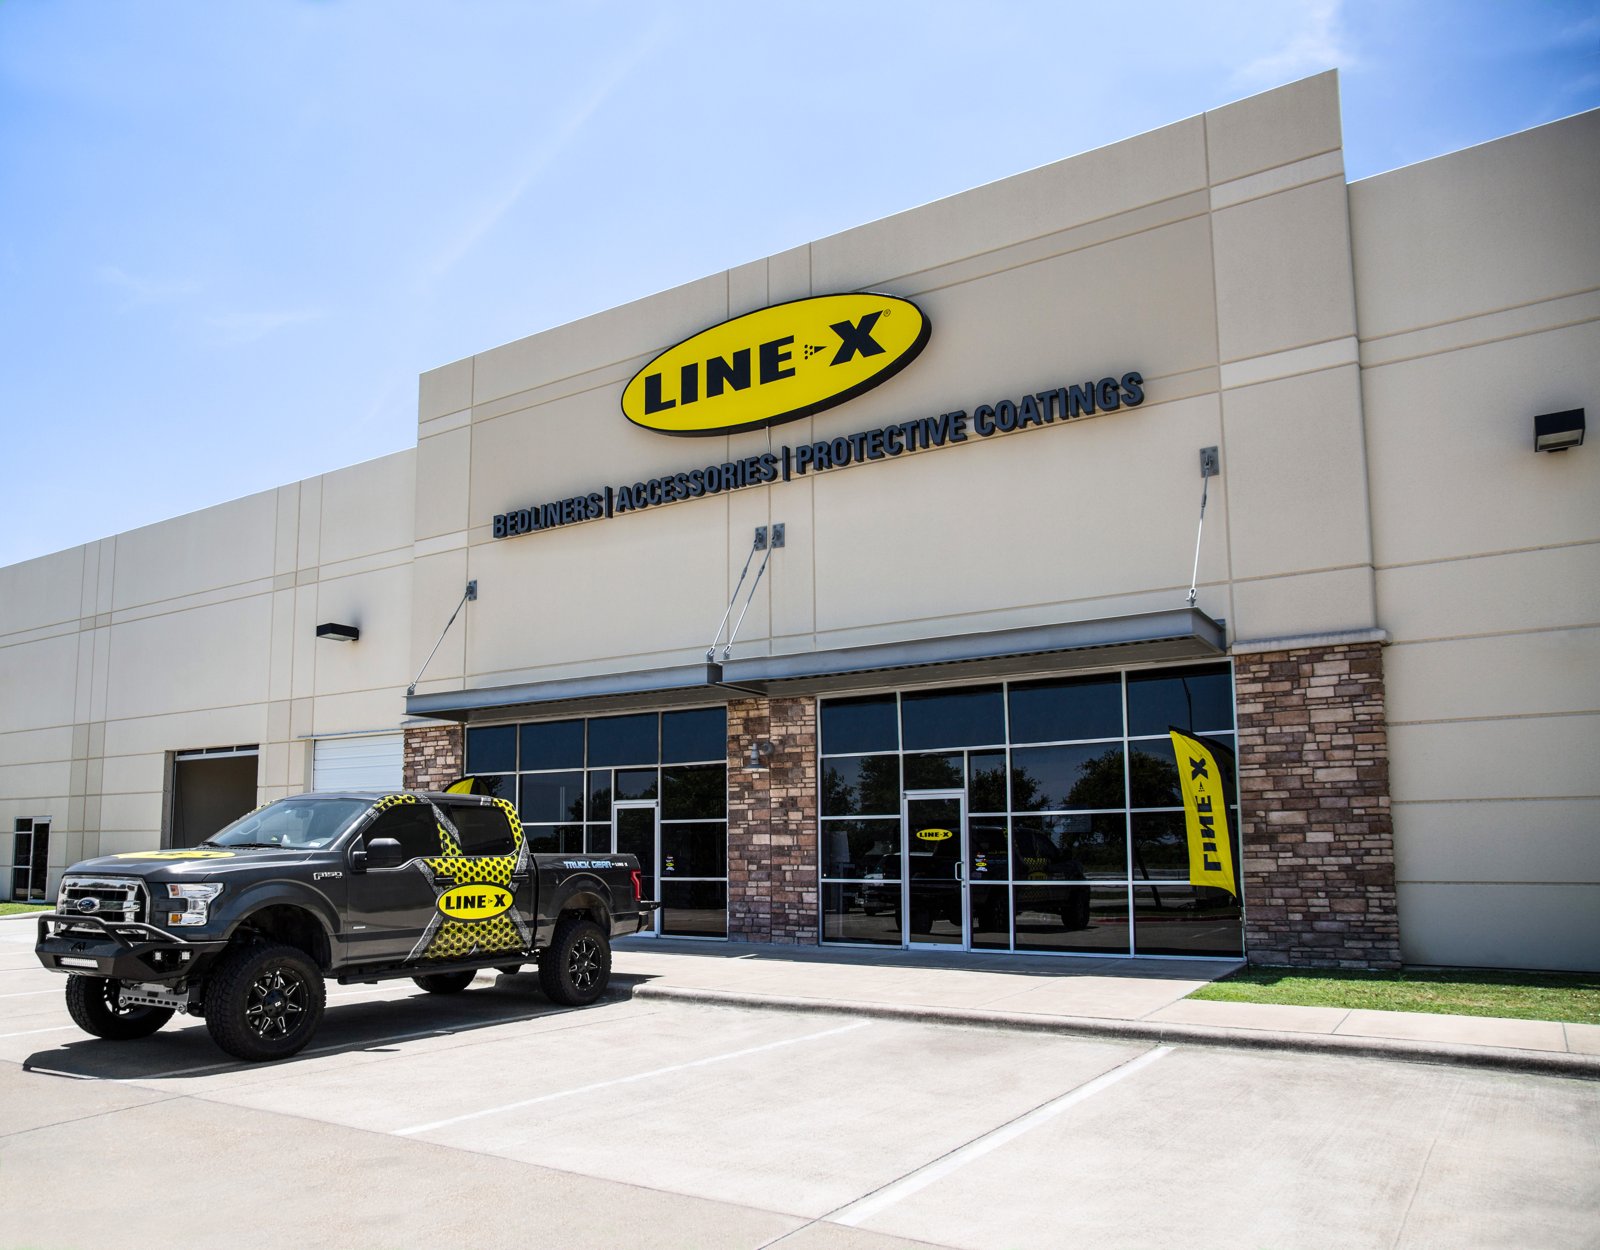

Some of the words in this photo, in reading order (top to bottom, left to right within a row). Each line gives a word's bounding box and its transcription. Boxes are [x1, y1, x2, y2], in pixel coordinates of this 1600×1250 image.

[493, 493, 603, 538] BEDLINERS
[615, 453, 778, 512] ACCESSORIES
[796, 410, 968, 475] PROTECTIVE
[973, 372, 1144, 437] COATINGS
[445, 894, 506, 910] LINE-X
